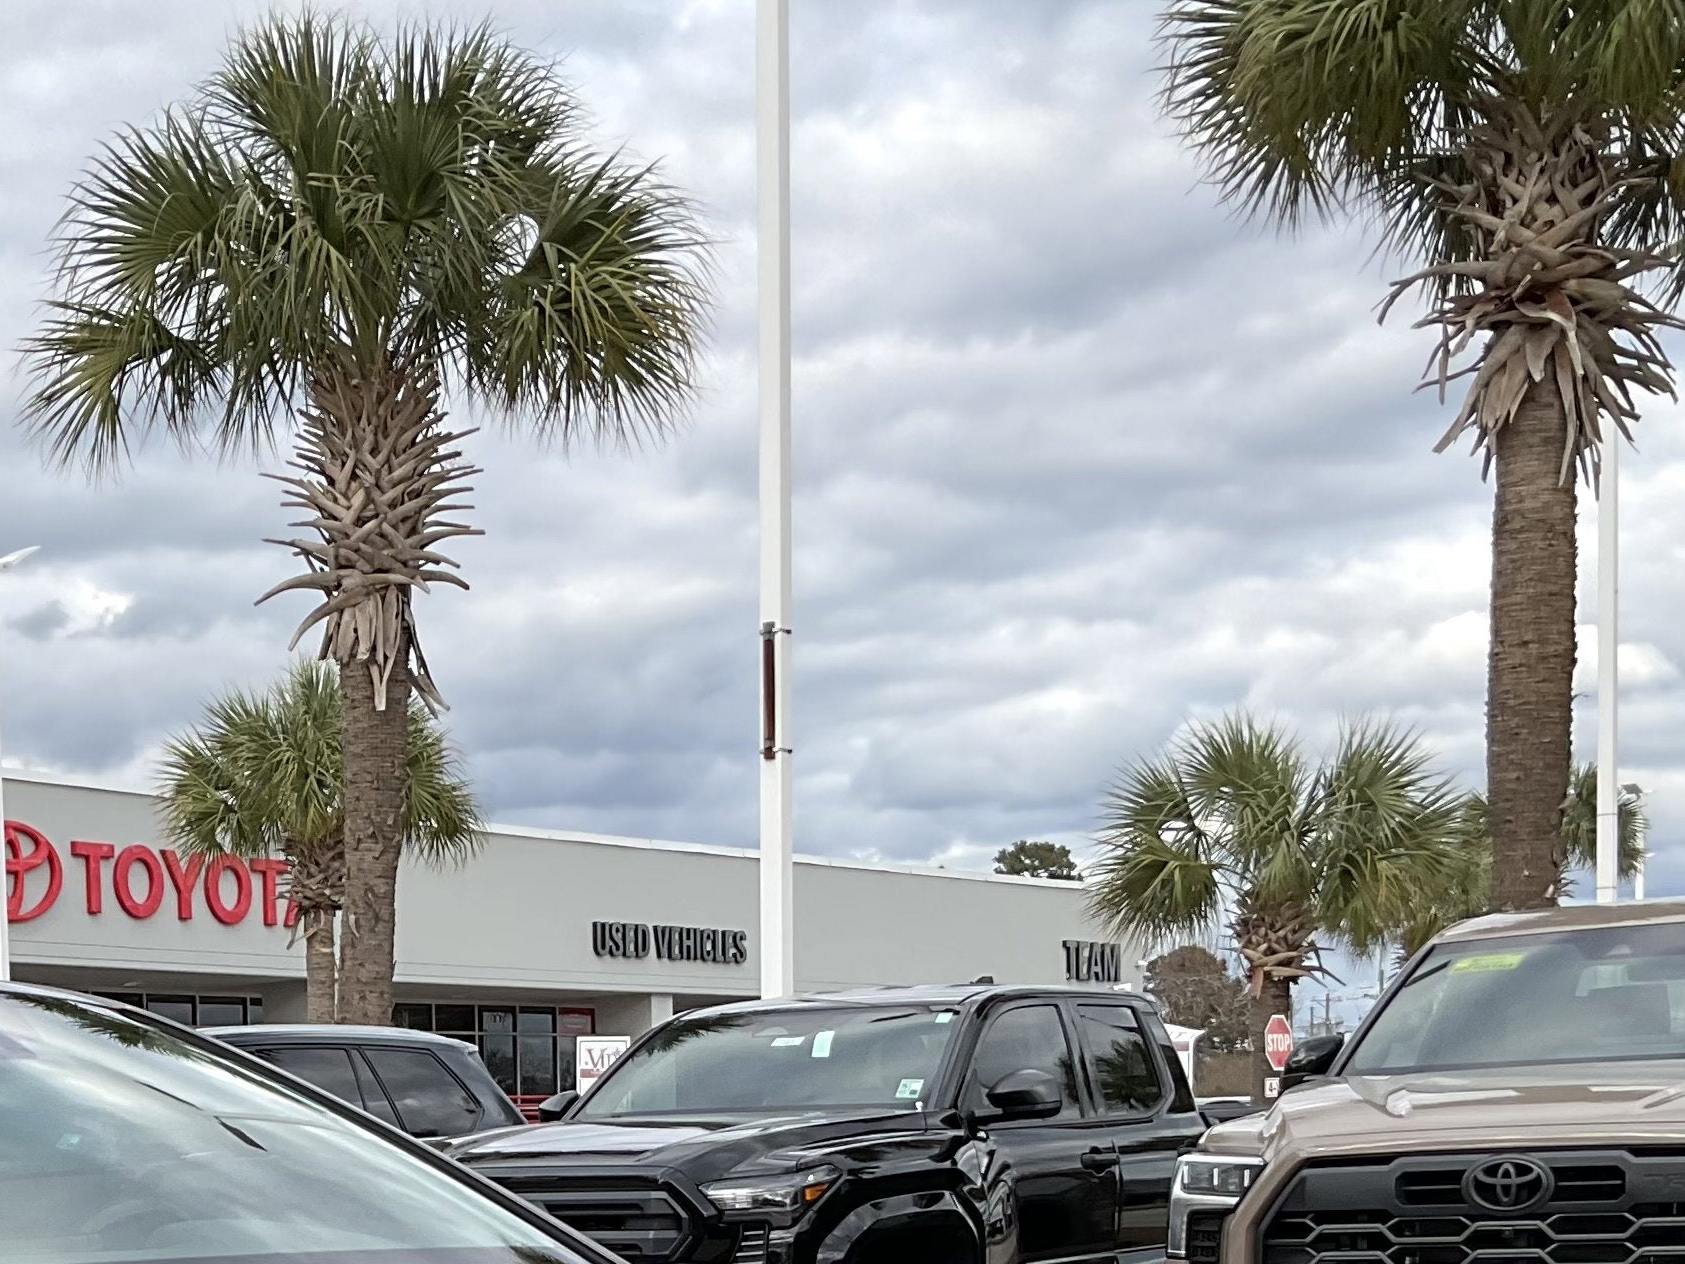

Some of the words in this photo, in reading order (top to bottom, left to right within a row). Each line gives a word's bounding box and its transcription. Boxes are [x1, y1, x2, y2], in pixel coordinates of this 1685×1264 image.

[71, 841, 301, 928] TOYOT
[592, 921, 651, 959] USED
[652, 925, 748, 965] VEHICLES
[1062, 940, 1121, 982] TEAM
[1267, 1033, 1290, 1052] STOP
